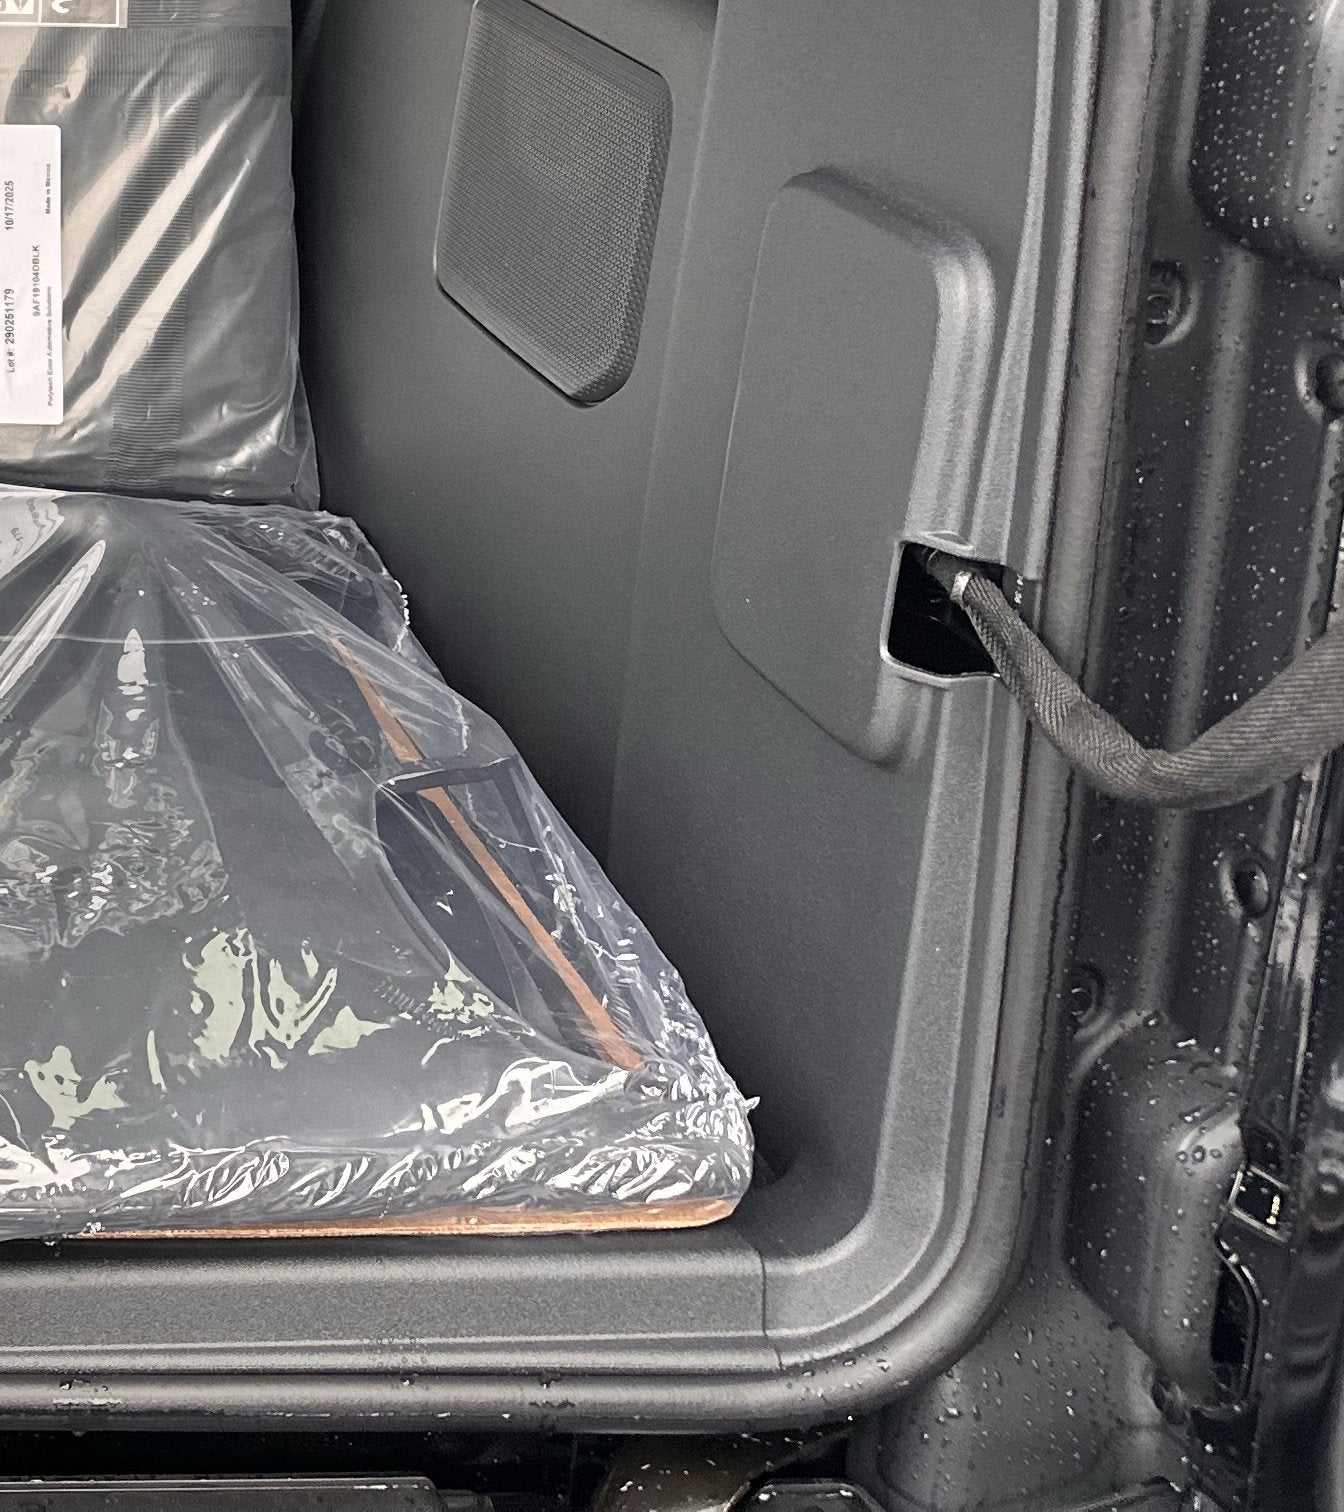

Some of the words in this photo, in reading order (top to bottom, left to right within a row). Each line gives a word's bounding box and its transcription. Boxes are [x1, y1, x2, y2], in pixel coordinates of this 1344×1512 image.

[4, 180, 14, 231] 10/17/2025
[4, 288, 15, 344] 290251179
[6, 359, 15, 373] Lot
